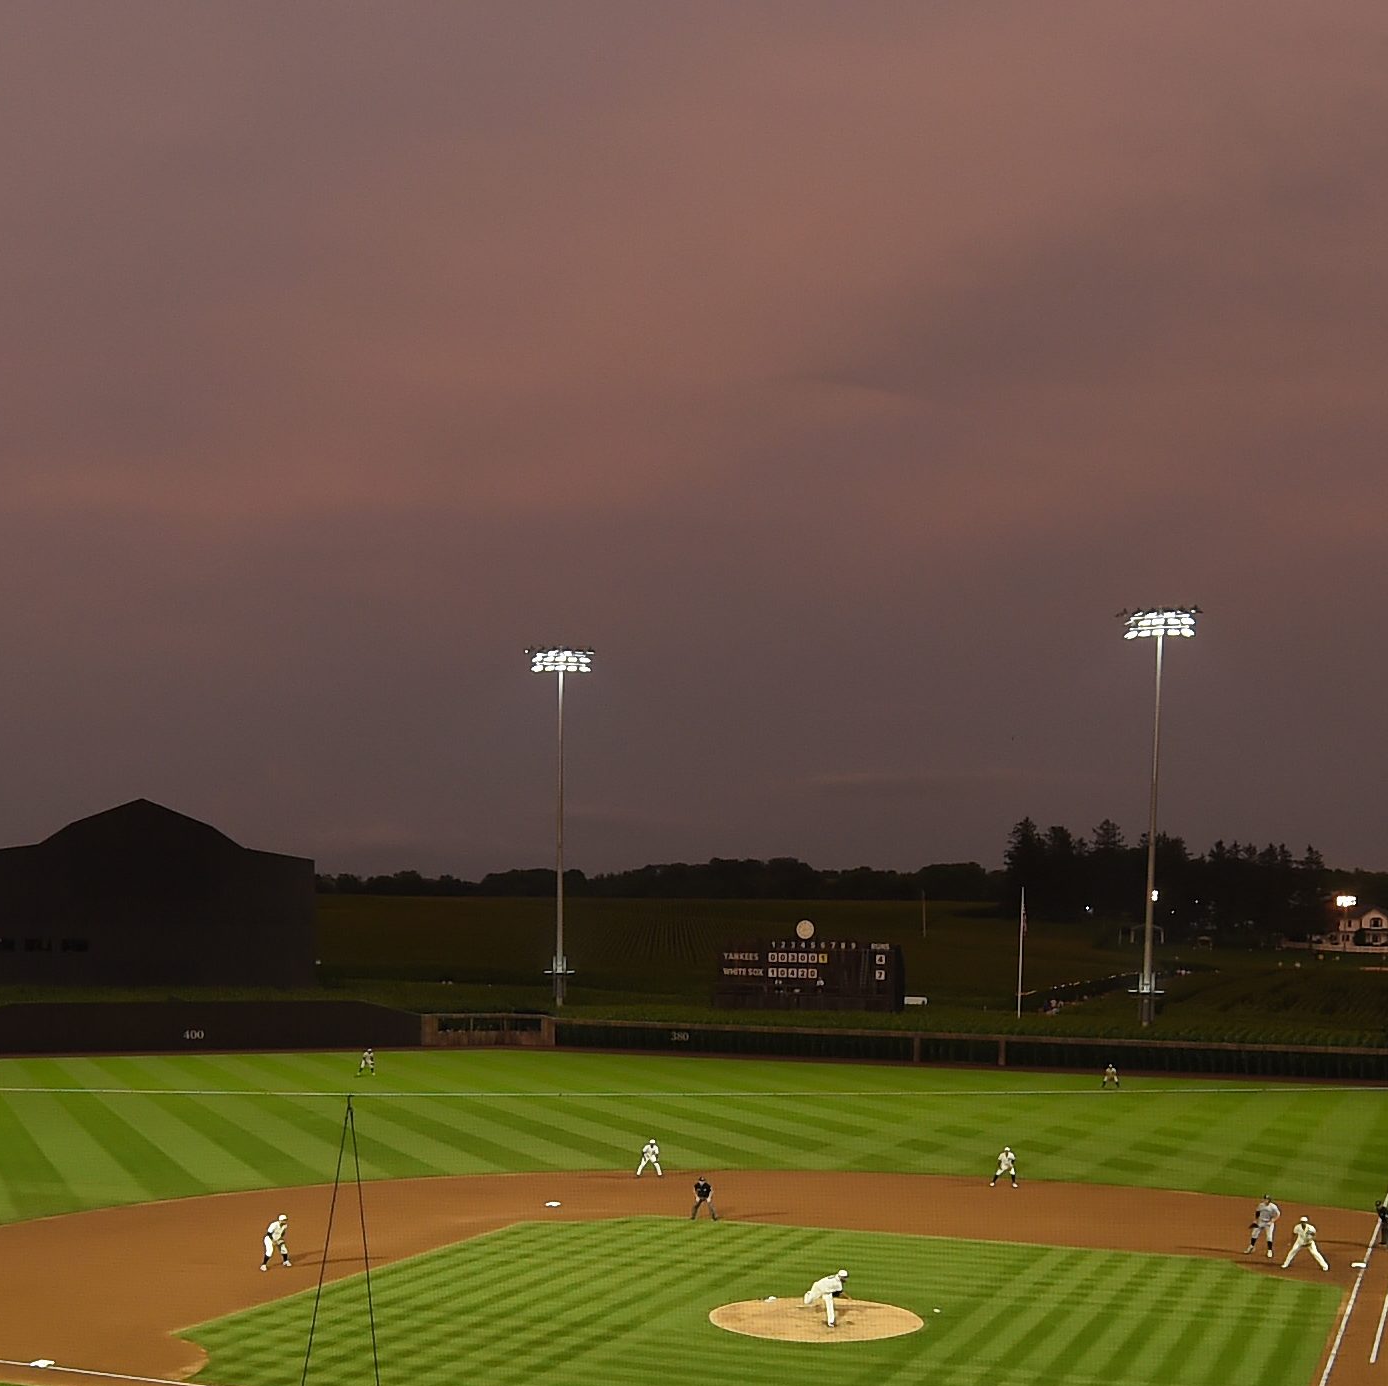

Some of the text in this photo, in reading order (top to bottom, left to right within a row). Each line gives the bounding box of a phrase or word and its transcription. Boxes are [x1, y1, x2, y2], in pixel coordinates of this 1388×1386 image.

[723, 953, 759, 961] YANKEES
[723, 968, 747, 976] WHITE
[747, 968, 764, 976] SOX
[671, 1031, 690, 1041] 380
